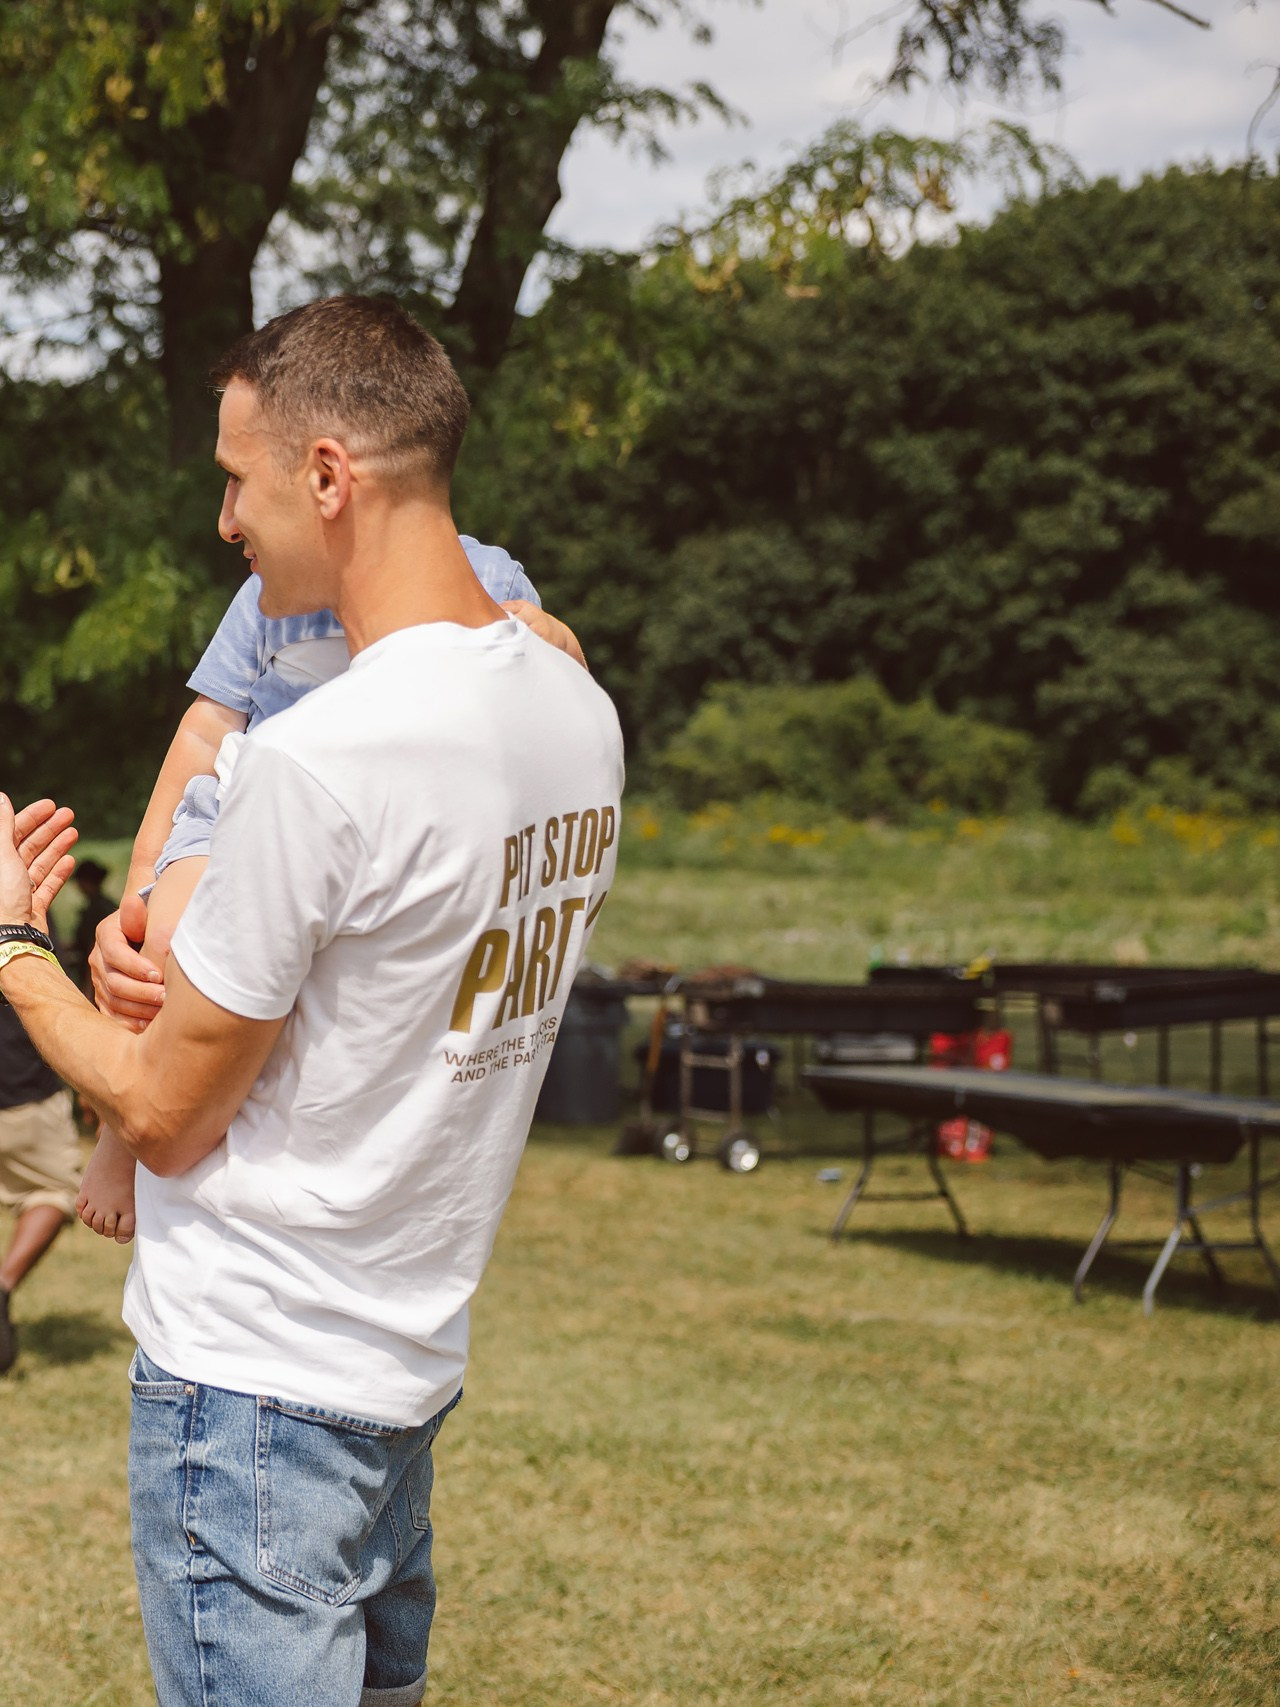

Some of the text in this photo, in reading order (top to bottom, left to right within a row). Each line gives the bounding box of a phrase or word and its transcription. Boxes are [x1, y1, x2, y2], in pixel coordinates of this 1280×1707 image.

[498, 805, 615, 909] PIT STOP
[443, 1016, 558, 1067] WHERE THE TCKS
[450, 1067, 486, 1083] AND
[489, 1056, 508, 1075] THE
